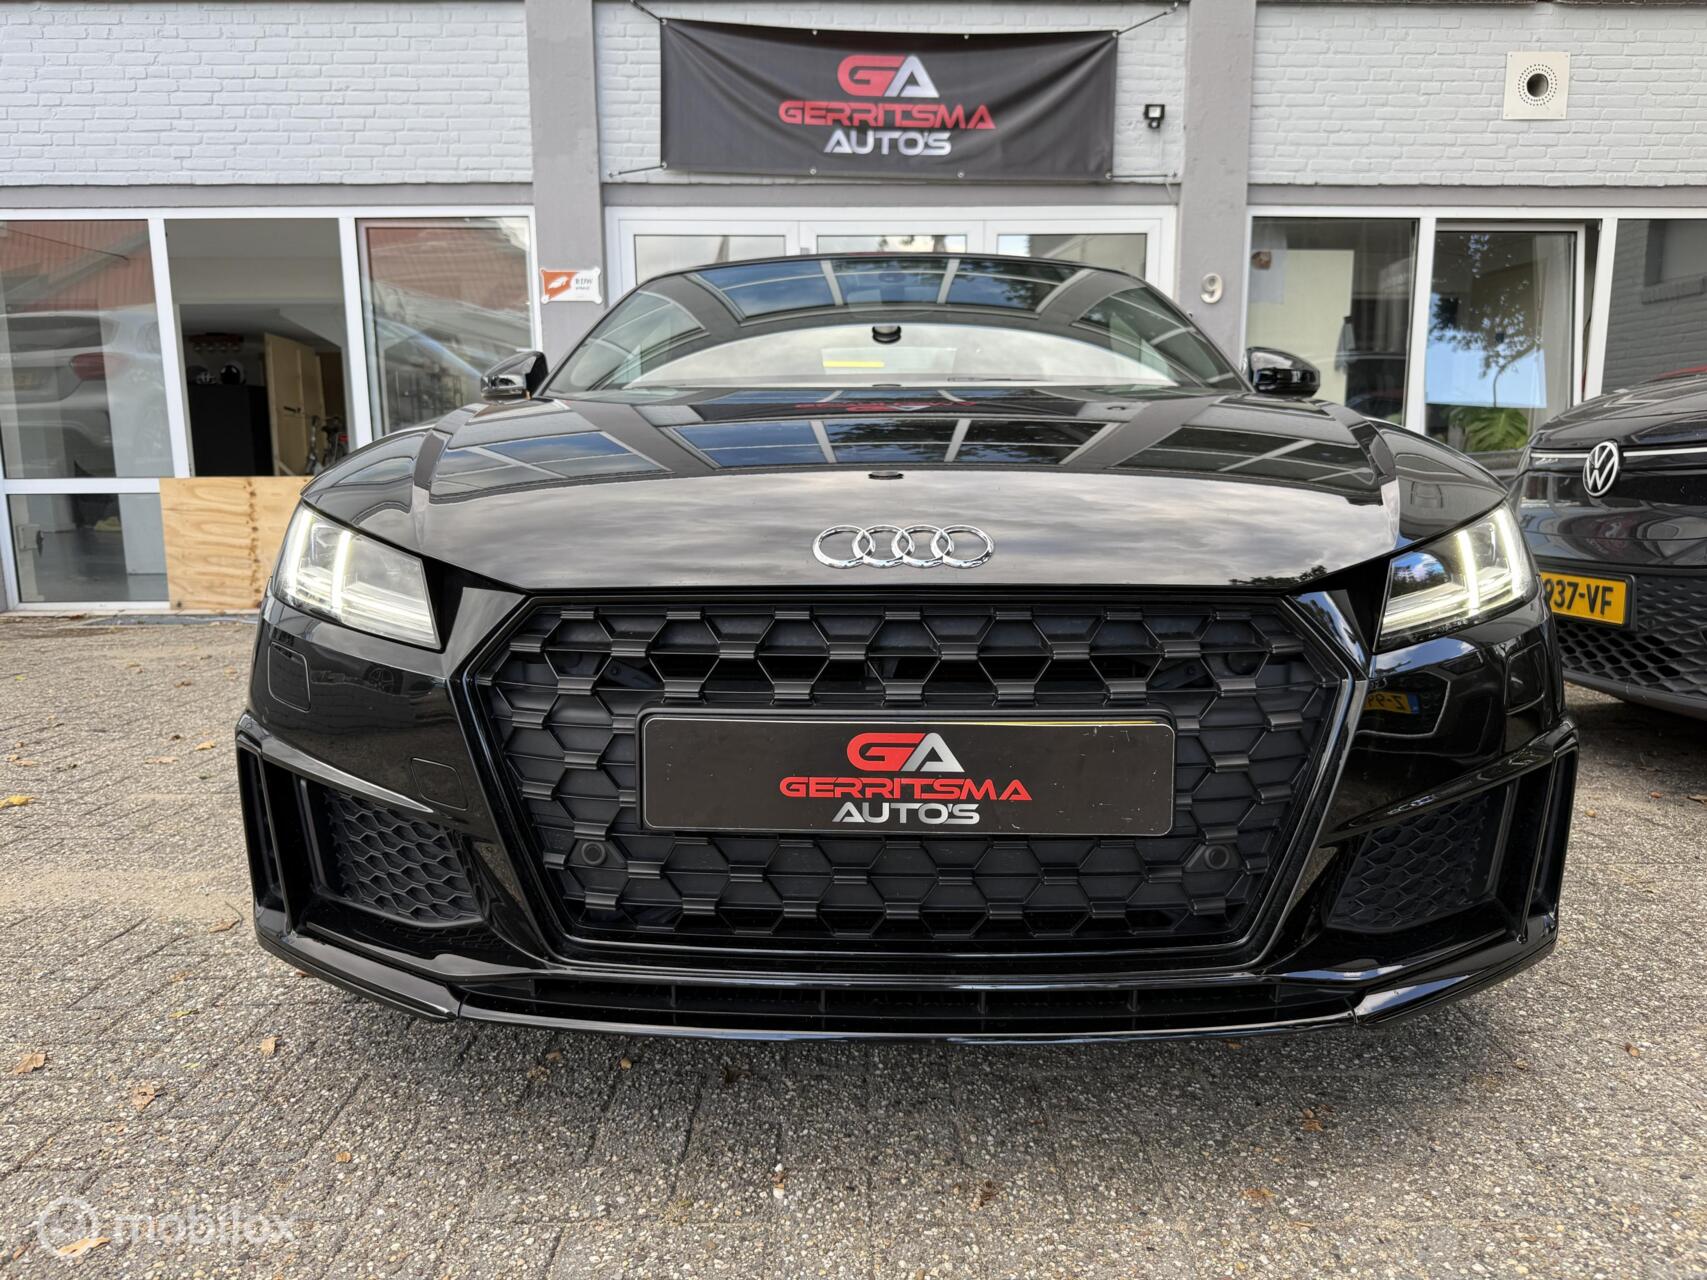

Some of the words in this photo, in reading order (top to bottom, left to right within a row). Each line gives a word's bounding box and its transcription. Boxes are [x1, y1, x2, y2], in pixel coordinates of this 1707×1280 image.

[837, 54, 940, 98] GA
[778, 100, 996, 130] GERRITSMA
[823, 128, 952, 156] AUTO'S
[1200, 272, 1223, 304] 9
[846, 732, 965, 772] GA
[779, 776, 1033, 801] GERRITSMA
[832, 801, 981, 825] AUTO'S
